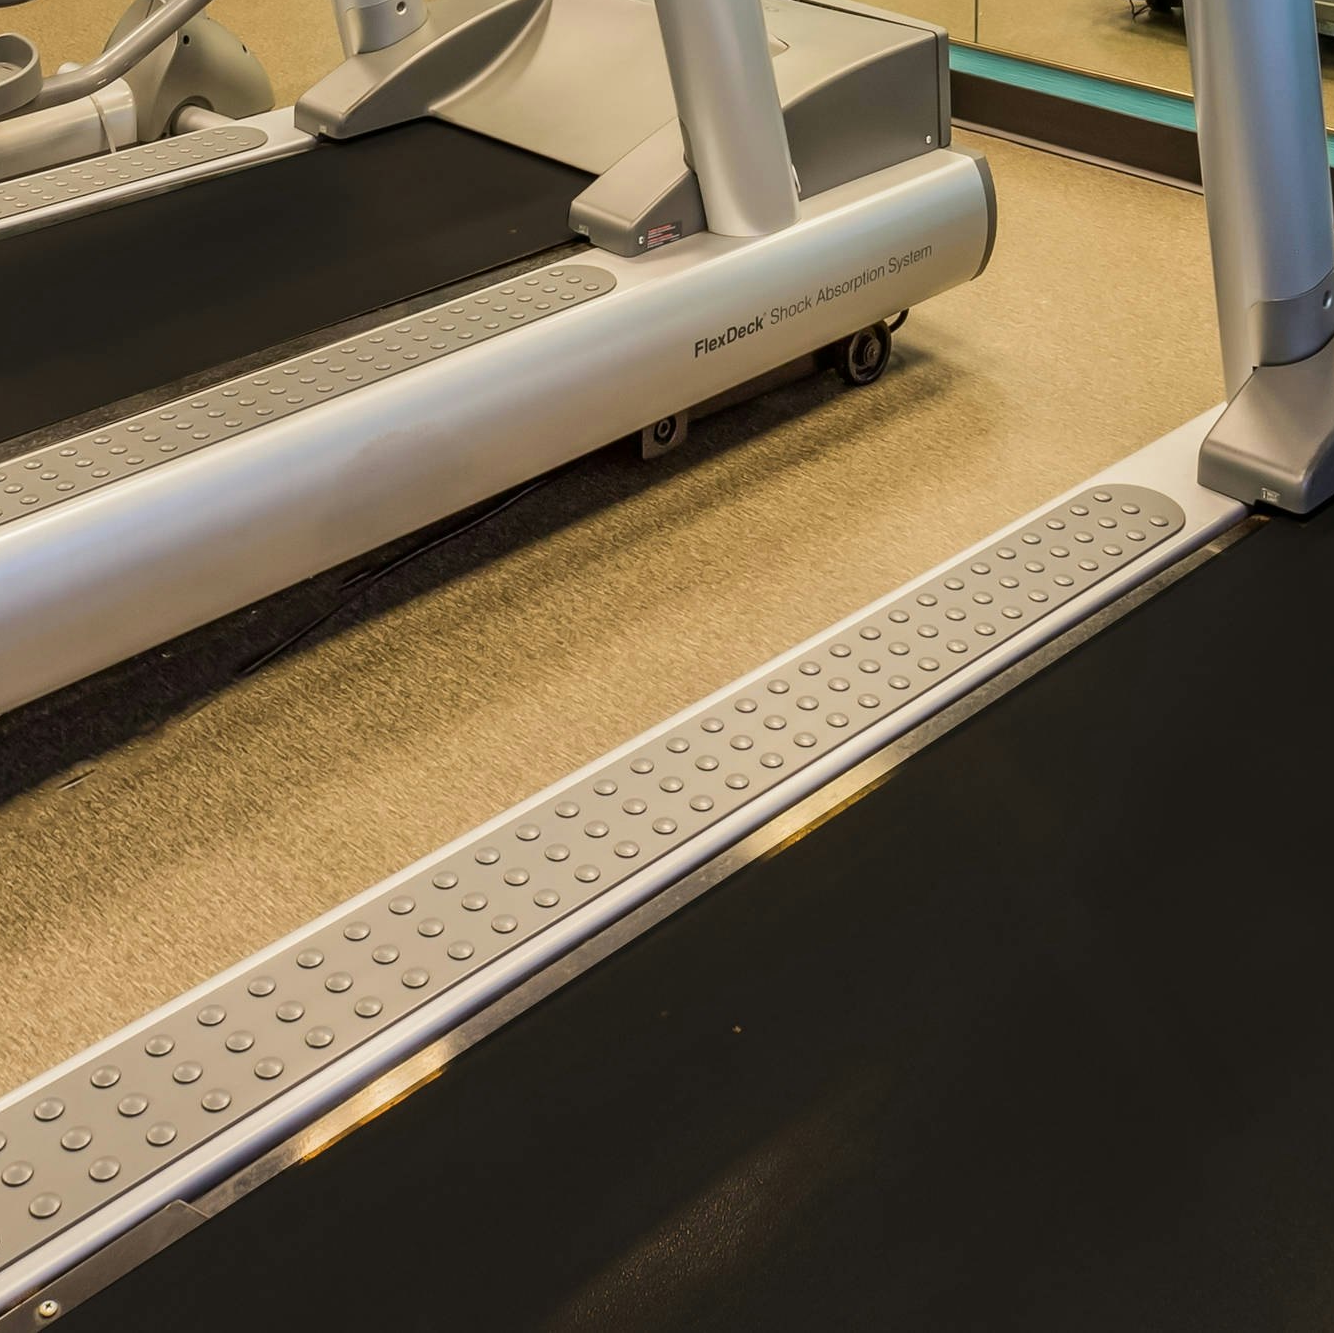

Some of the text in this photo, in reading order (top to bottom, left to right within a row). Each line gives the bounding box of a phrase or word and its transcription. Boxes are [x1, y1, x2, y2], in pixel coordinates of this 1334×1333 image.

[694, 244, 932, 358] FlexDeck Shock Absorption System
